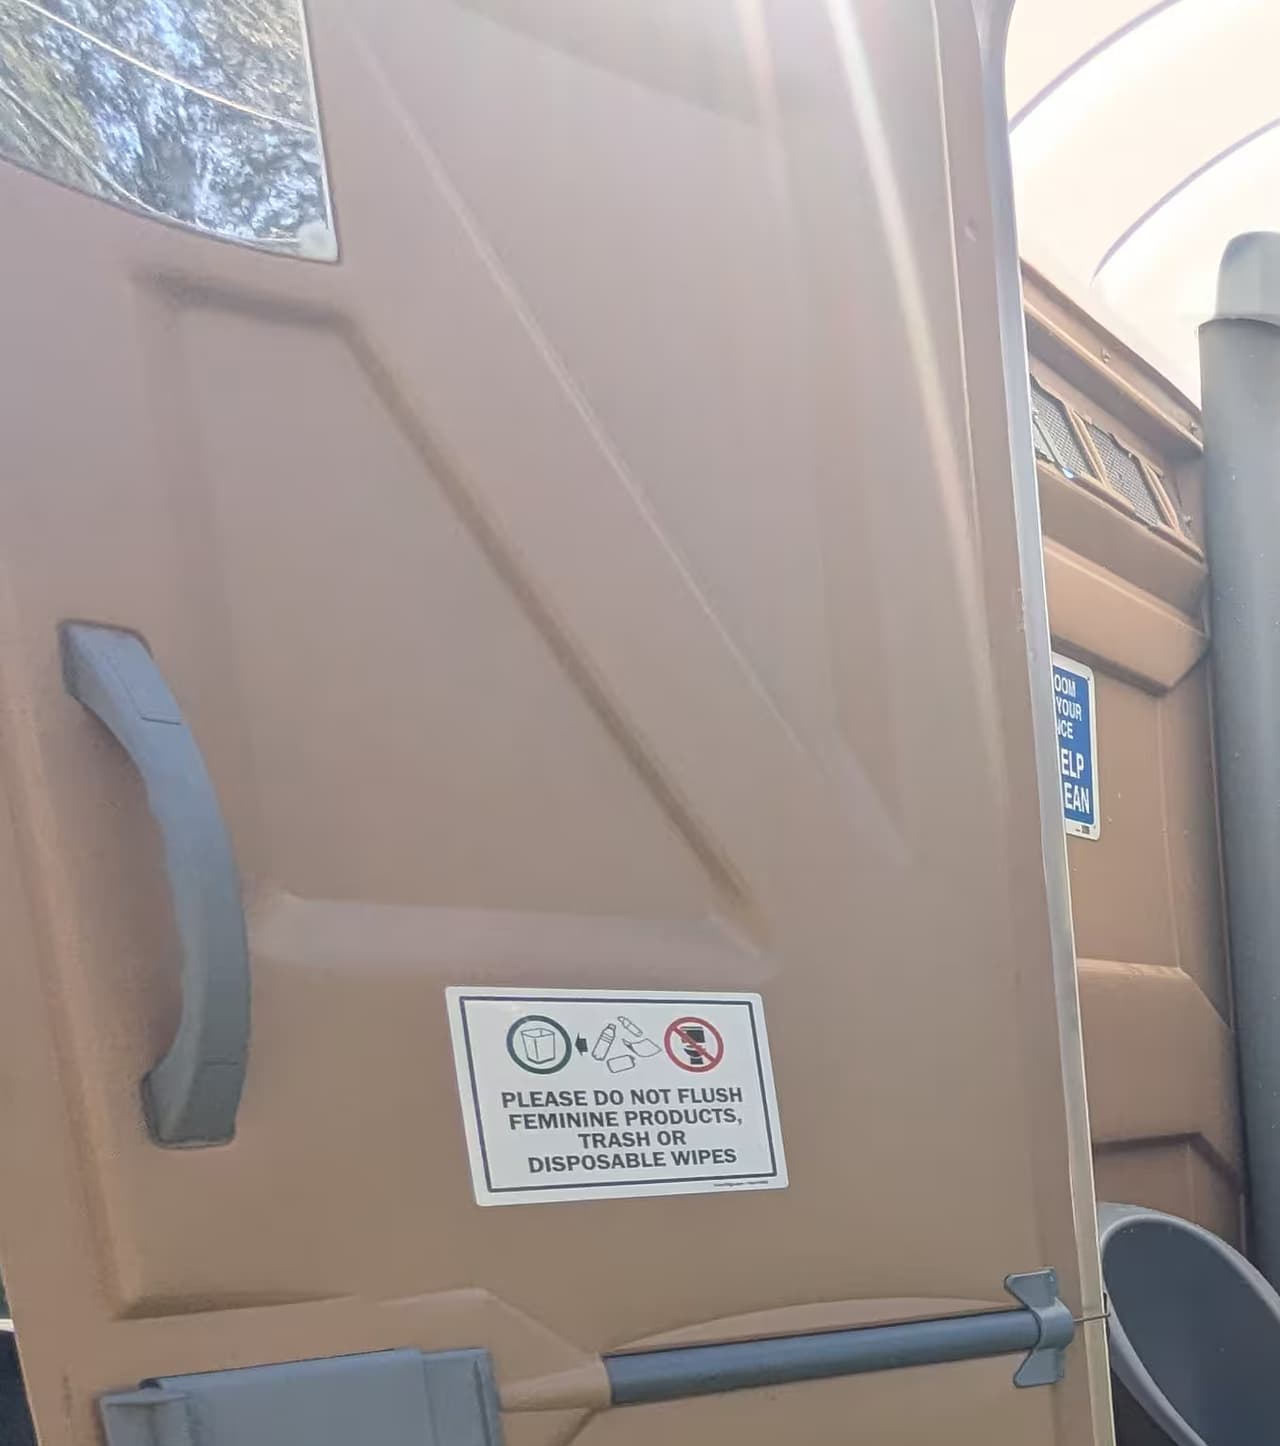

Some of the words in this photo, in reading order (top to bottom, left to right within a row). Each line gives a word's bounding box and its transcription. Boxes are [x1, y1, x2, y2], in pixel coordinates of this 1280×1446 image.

[1054, 674, 1076, 698] OOM
[1056, 696, 1082, 721] YOUR
[1061, 748, 1085, 779] ELP
[1064, 782, 1090, 815] EAN
[501, 1090, 587, 1109] PLEASE
[593, 1089, 624, 1107] DO
[631, 1088, 671, 1105] NOT
[678, 1087, 743, 1104] FLUSH
[508, 1110, 619, 1131] FEMININE
[625, 1108, 743, 1127] PRODUCTS,
[577, 1131, 650, 1150] TRASH
[656, 1130, 687, 1146] OR
[527, 1151, 667, 1174] DISPOSABLE
[670, 1148, 737, 1166] WIPES
